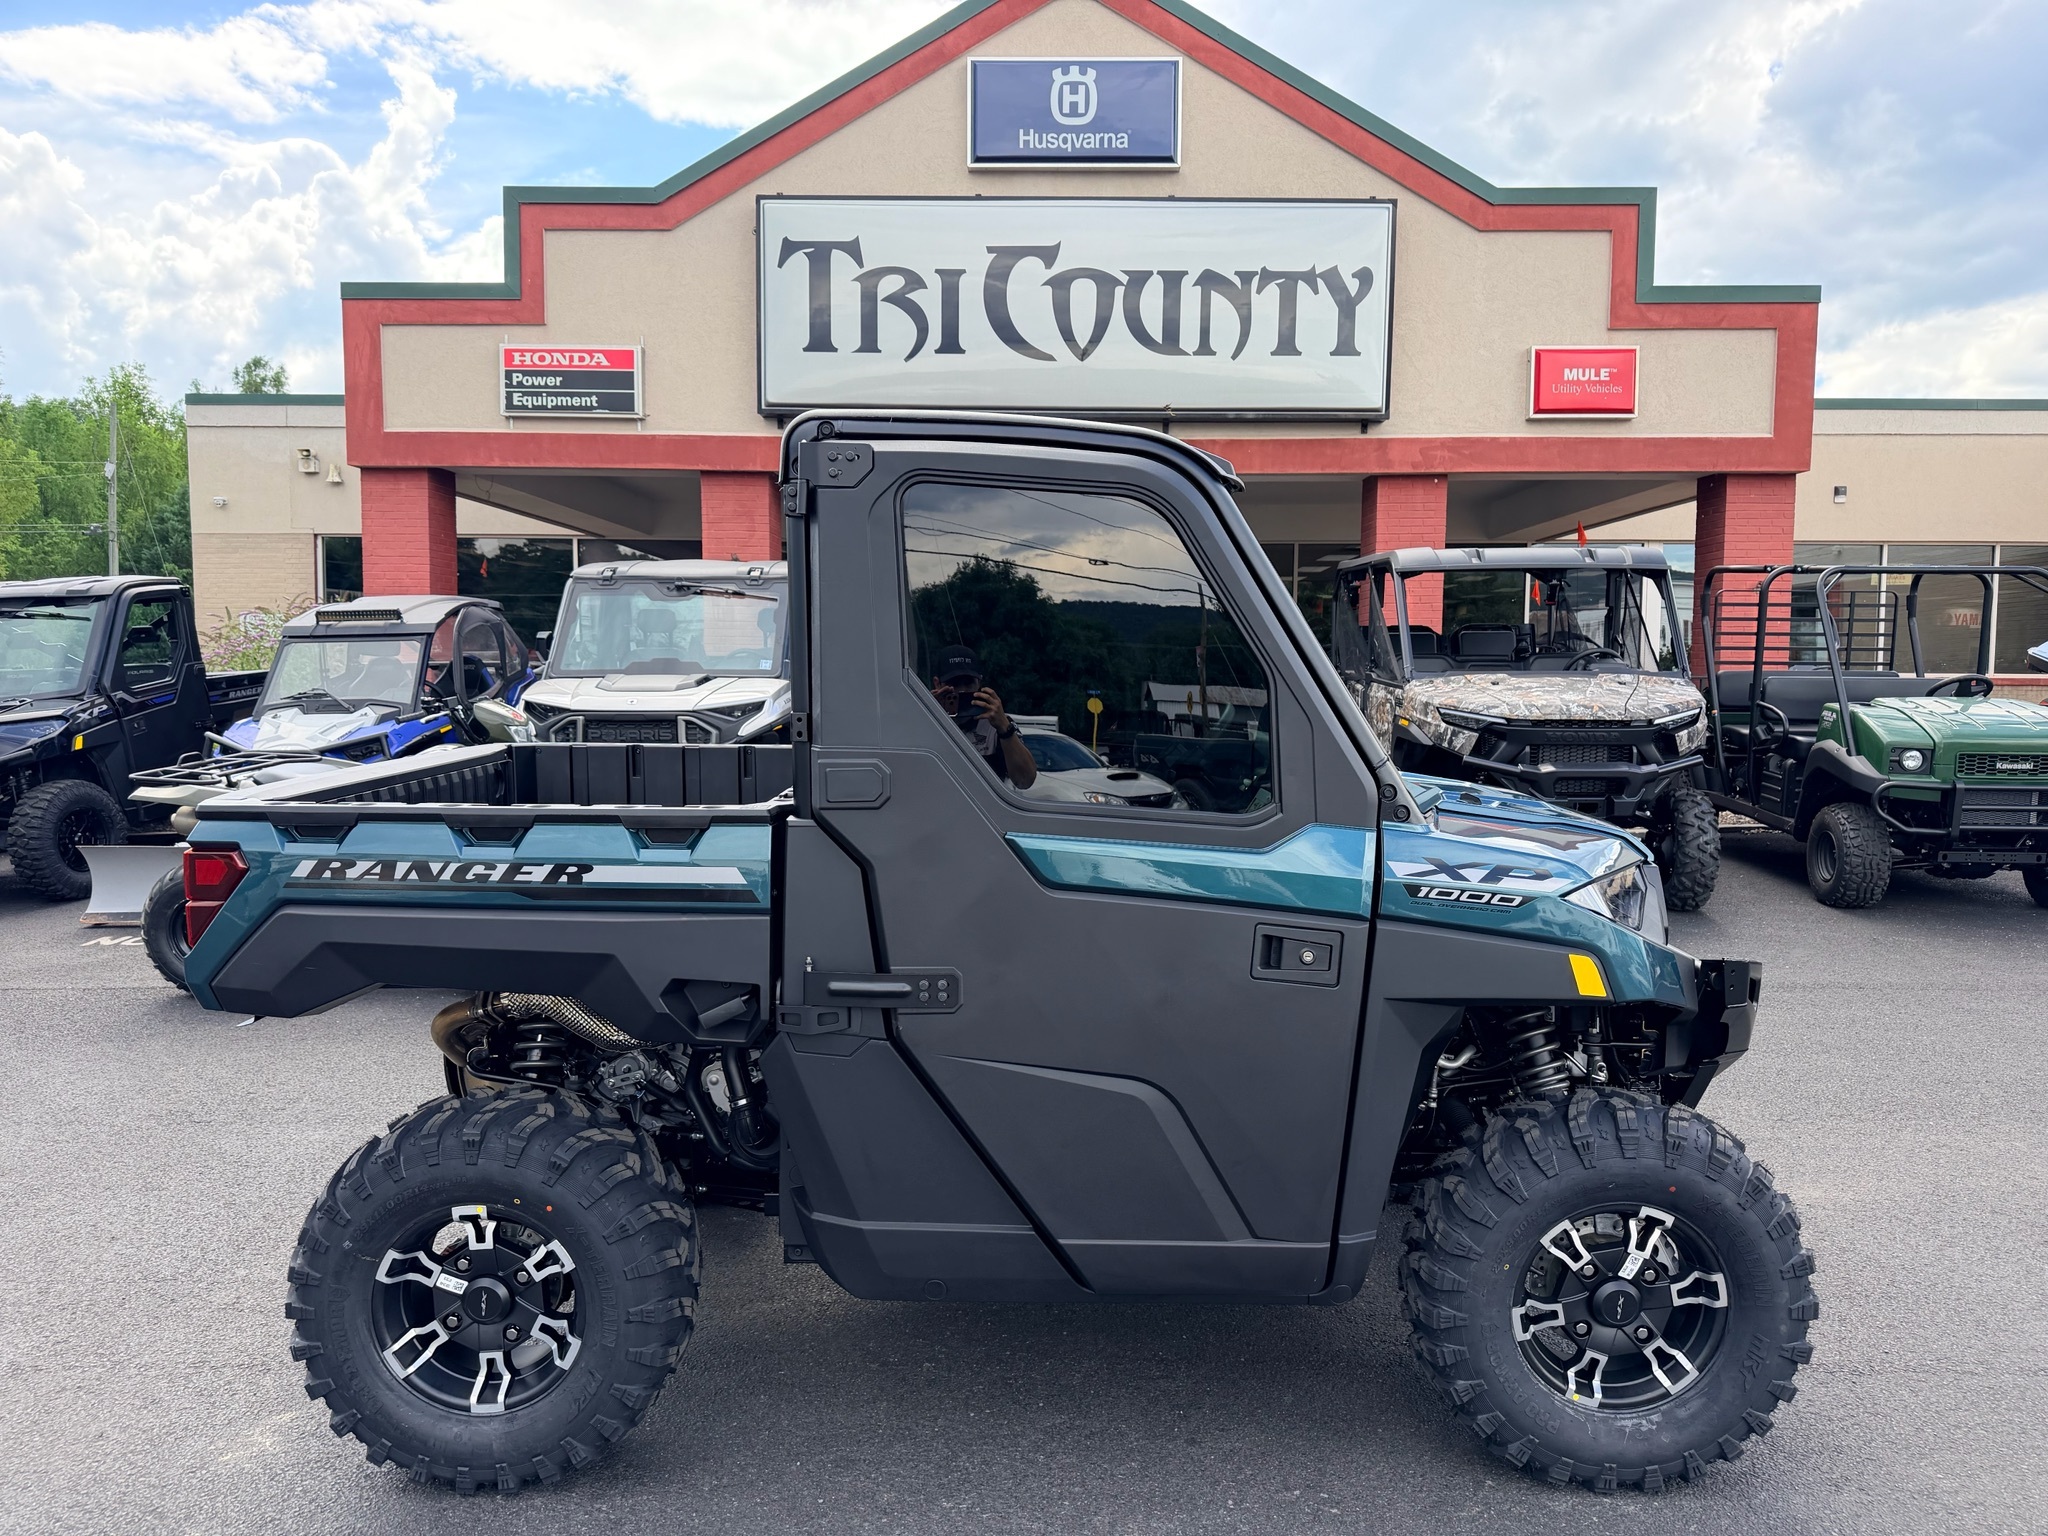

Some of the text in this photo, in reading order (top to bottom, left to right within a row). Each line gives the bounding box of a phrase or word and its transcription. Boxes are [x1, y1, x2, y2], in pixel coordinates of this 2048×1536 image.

[1019, 128, 1129, 152] Husqvarna
[511, 352, 611, 366] HONDA
[512, 372, 563, 387] Power
[1551, 383, 1623, 395] Utility Vehicles
[512, 393, 599, 409] Equipment
[1954, 613, 1981, 626] YAM
[228, 687, 263, 699] RANGER
[75, 704, 108, 724] XP
[588, 728, 674, 741] POLARIS
[1545, 731, 1623, 742] HONDA
[1996, 762, 2034, 770] Kawasaki
[304, 858, 594, 885] RANGER
[1402, 856, 1554, 886] XP
[1417, 886, 1523, 907] 1000
[1438, 903, 1489, 913] OVERHEAD
[1490, 907, 1512, 915] CAM
[1694, 1194, 1773, 1307] X-TERRAIN
[565, 1221, 619, 1348] X-TERRAIN
[1485, 1341, 1561, 1434] PRO ARMOR
